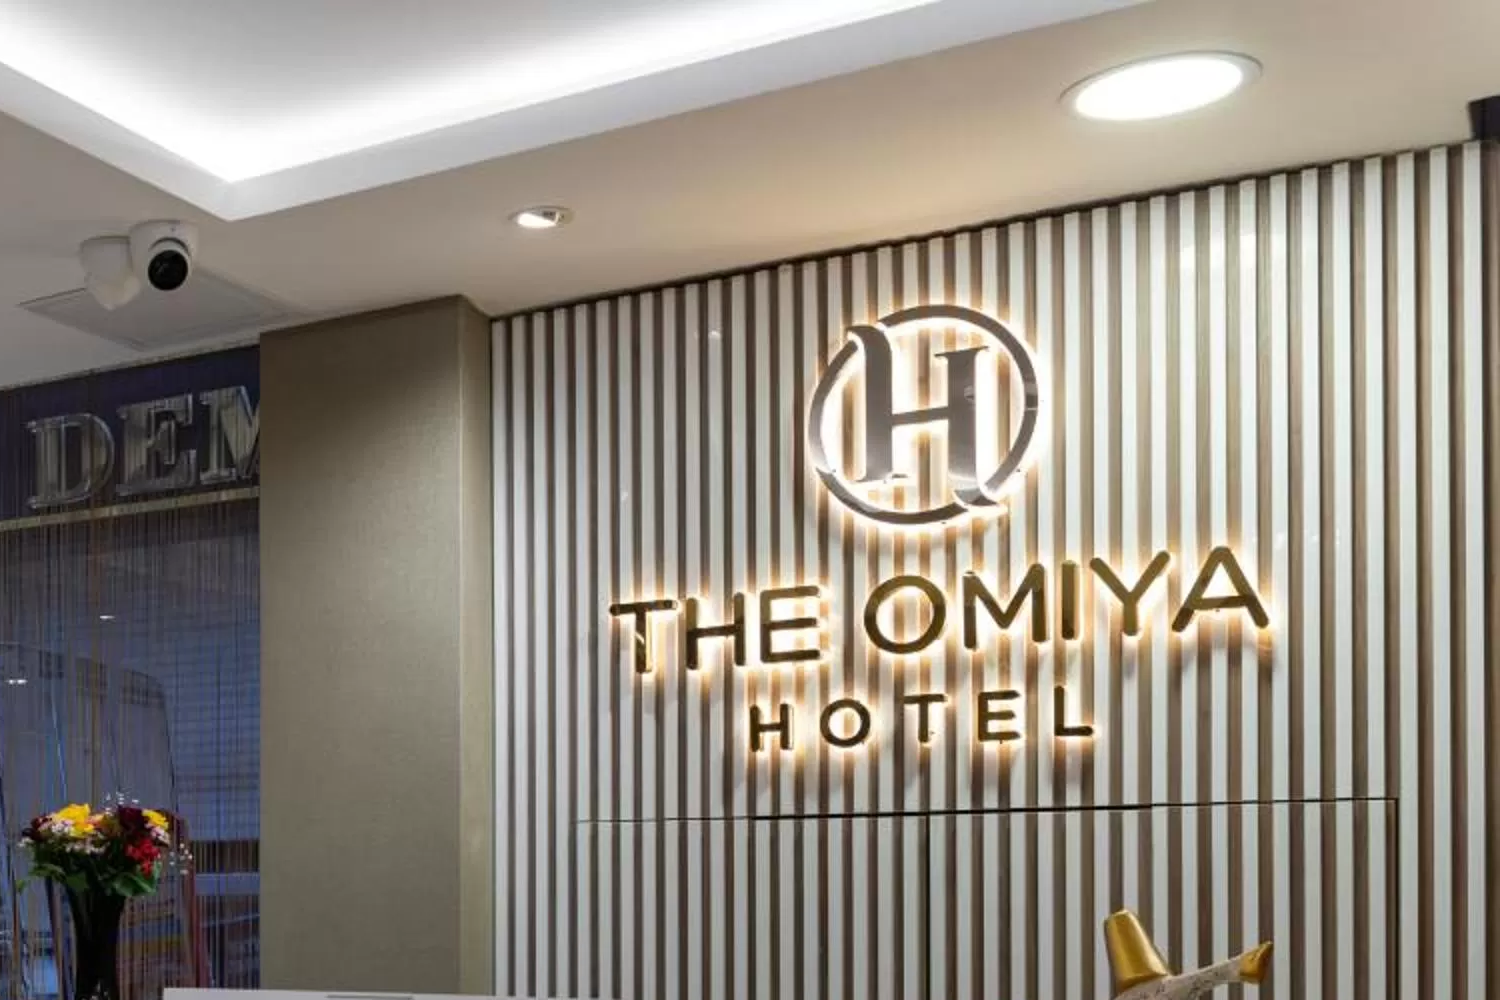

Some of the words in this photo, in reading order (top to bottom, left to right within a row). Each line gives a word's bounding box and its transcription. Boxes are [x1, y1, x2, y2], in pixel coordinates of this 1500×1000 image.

[842, 320, 1004, 509] H
[608, 584, 822, 675] THE
[863, 545, 1270, 655] OMIYA
[748, 685, 1095, 753] HOTEL
